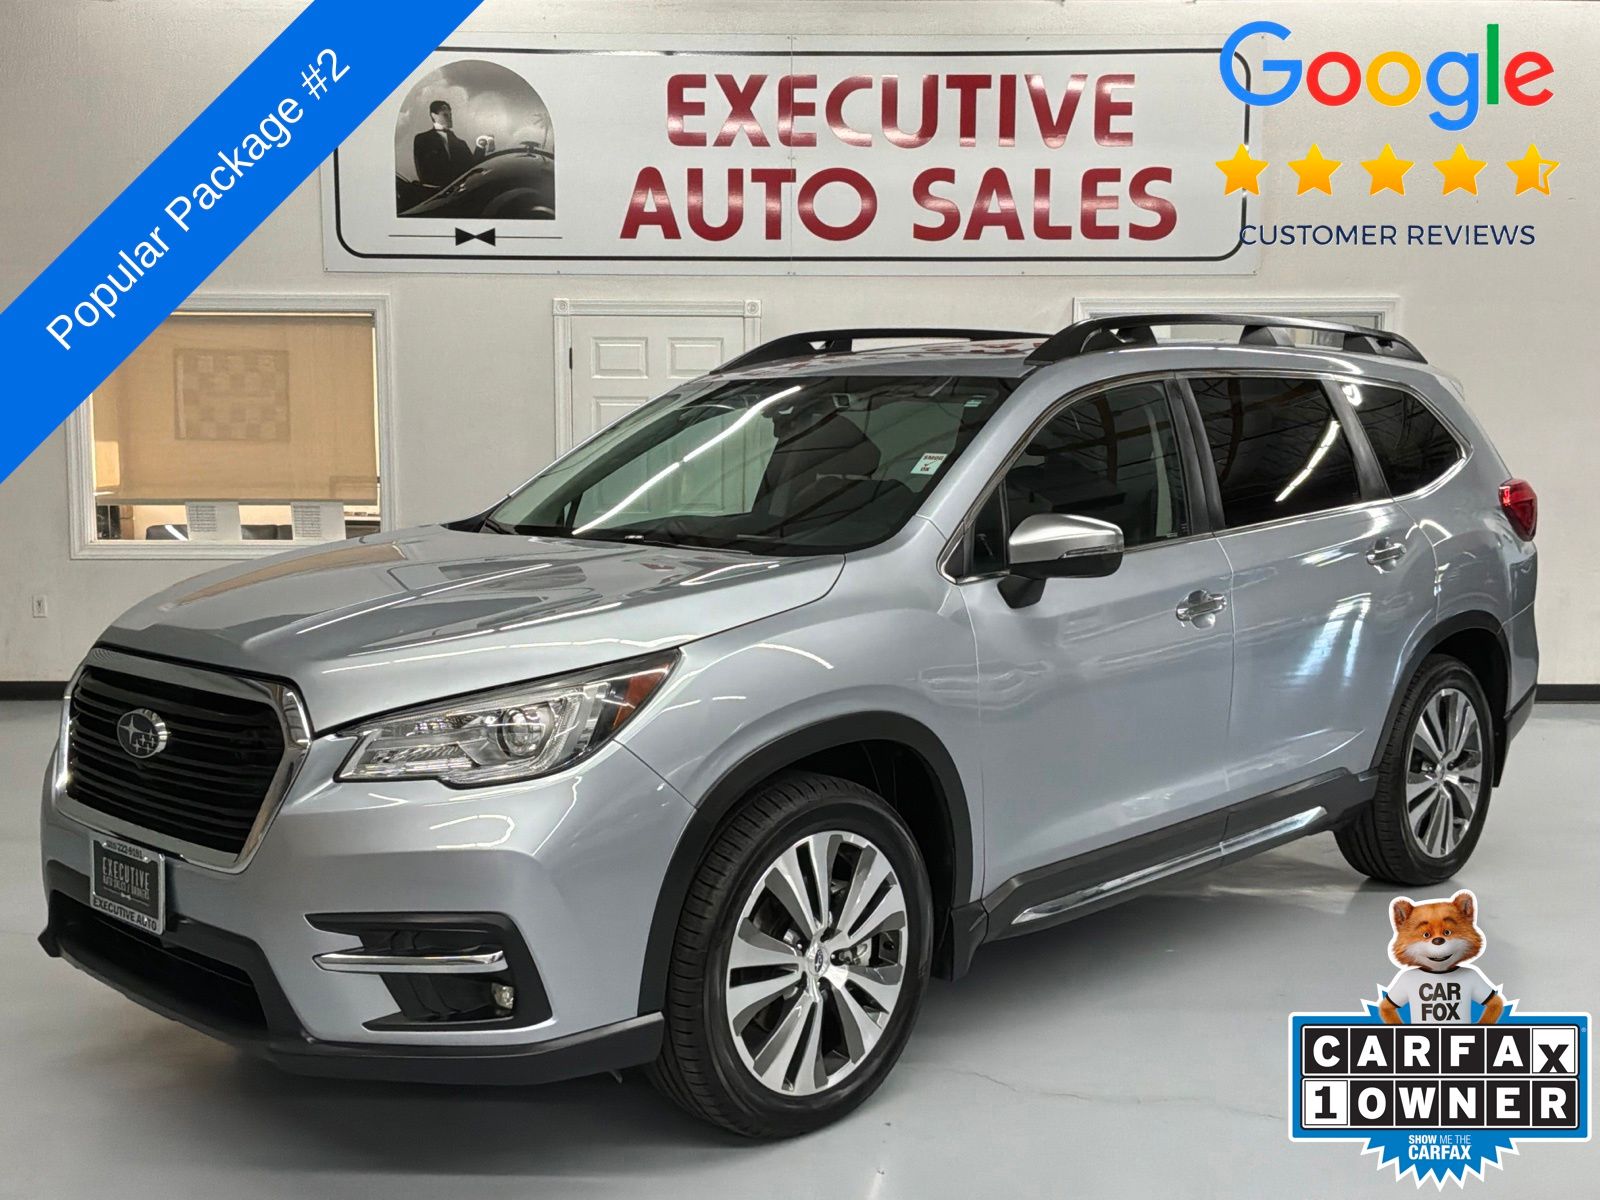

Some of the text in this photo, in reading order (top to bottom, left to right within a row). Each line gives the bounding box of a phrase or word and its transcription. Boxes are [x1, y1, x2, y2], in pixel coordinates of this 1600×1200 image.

[667, 73, 1136, 149] EXECUTIVE
[619, 166, 1177, 242] AUTO SALES
[102, 856, 150, 891] EXECUTIVE
[93, 897, 157, 931] EXECUTIVE AUTO
